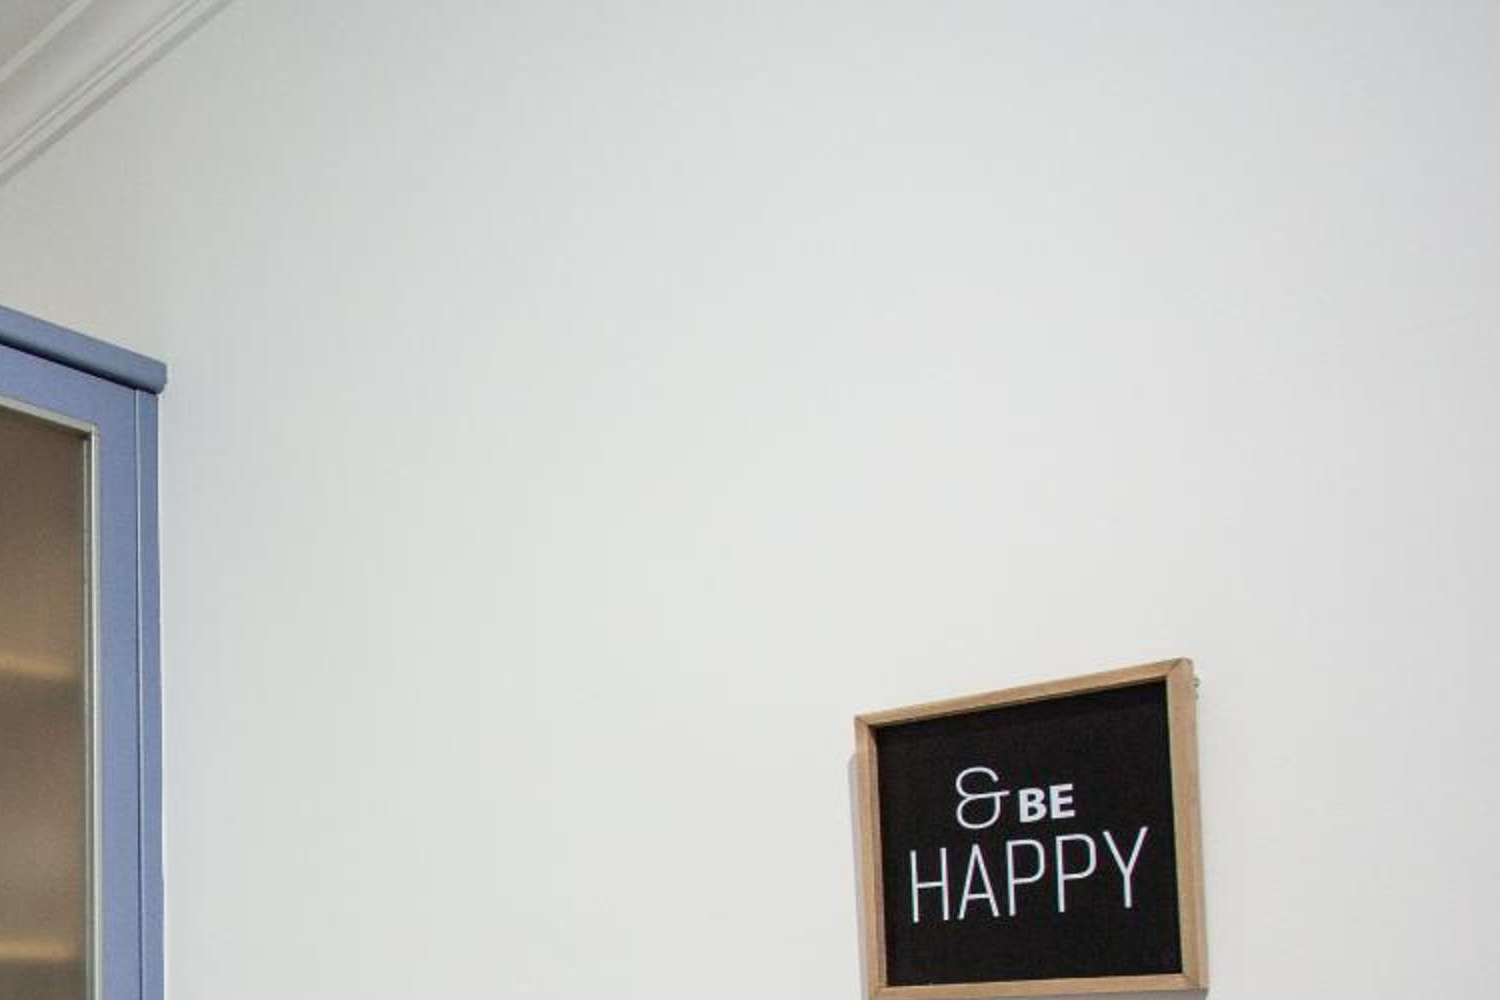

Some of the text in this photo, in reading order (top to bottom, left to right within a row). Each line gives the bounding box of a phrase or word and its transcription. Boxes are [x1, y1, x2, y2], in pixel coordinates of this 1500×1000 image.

[955, 766, 1076, 829] & BE
[910, 826, 1148, 923] HAPPY
